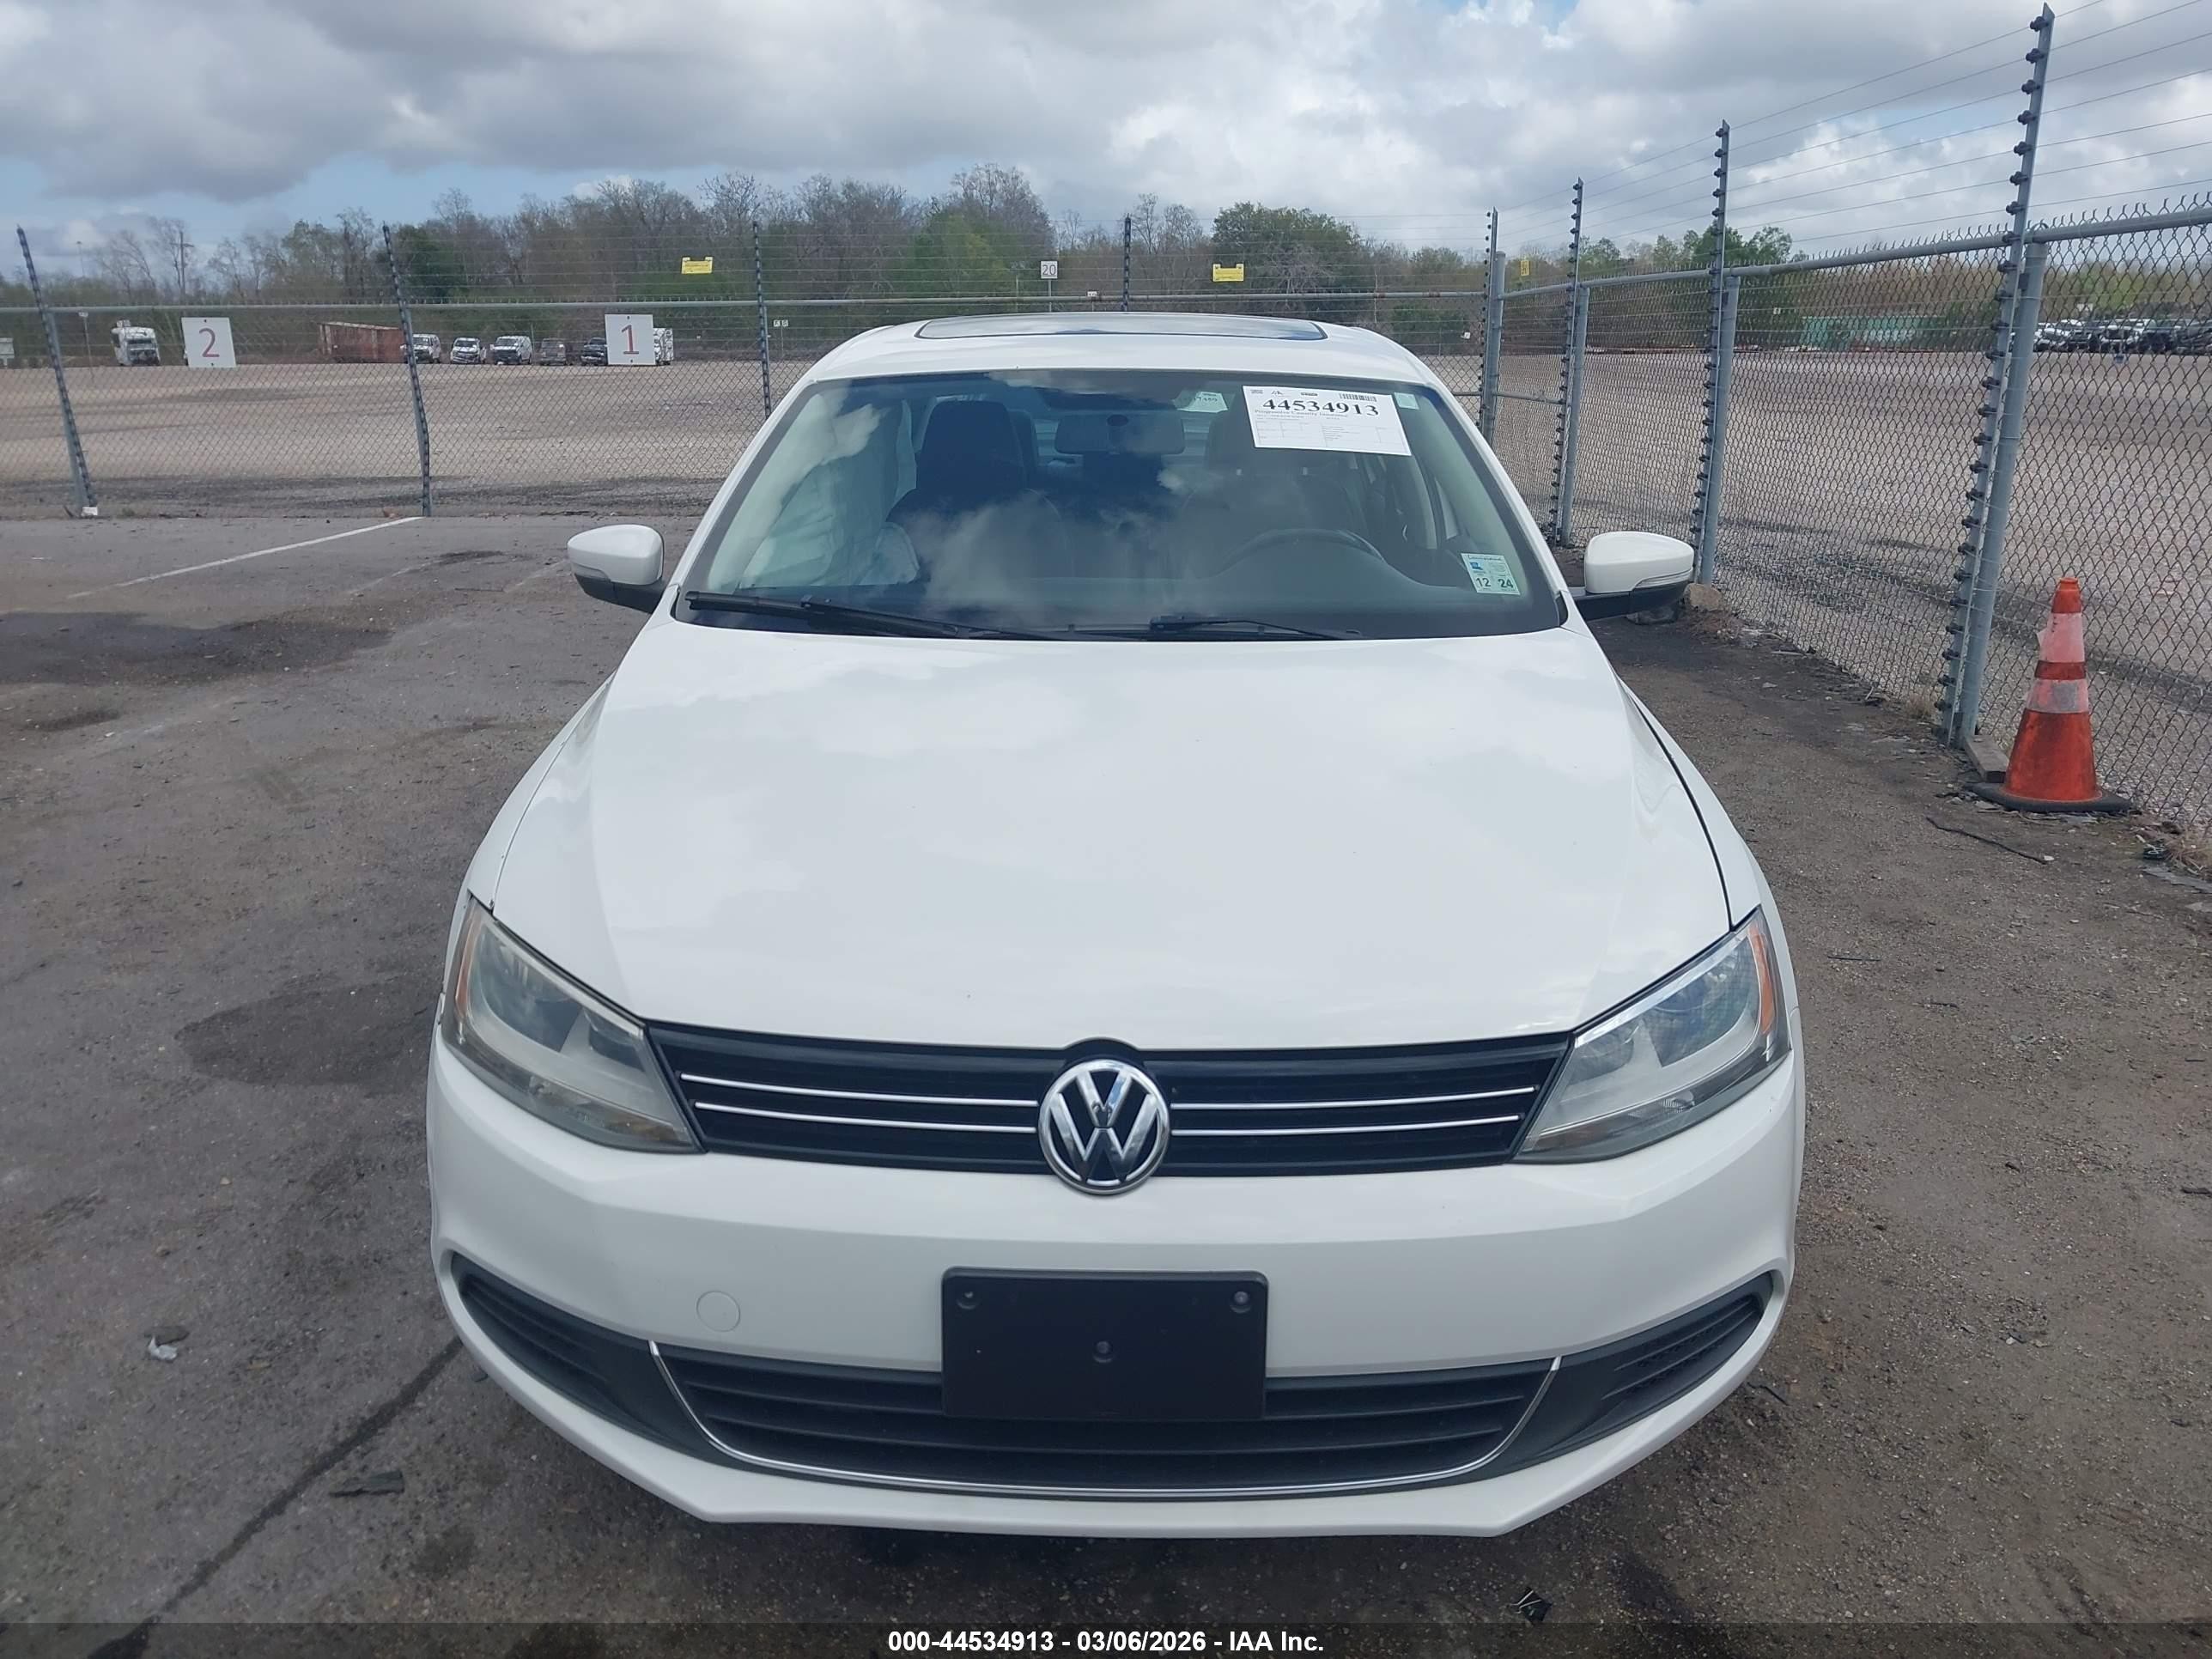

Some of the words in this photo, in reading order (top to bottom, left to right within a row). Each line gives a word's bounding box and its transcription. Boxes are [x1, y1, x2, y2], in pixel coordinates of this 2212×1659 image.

[1042, 264, 1057, 276] 20
[198, 327, 220, 358] 2
[621, 325, 640, 355] 1
[1262, 398, 1379, 416] 44534913
[1475, 577, 1492, 587] 12
[1498, 578, 1514, 588] 24
